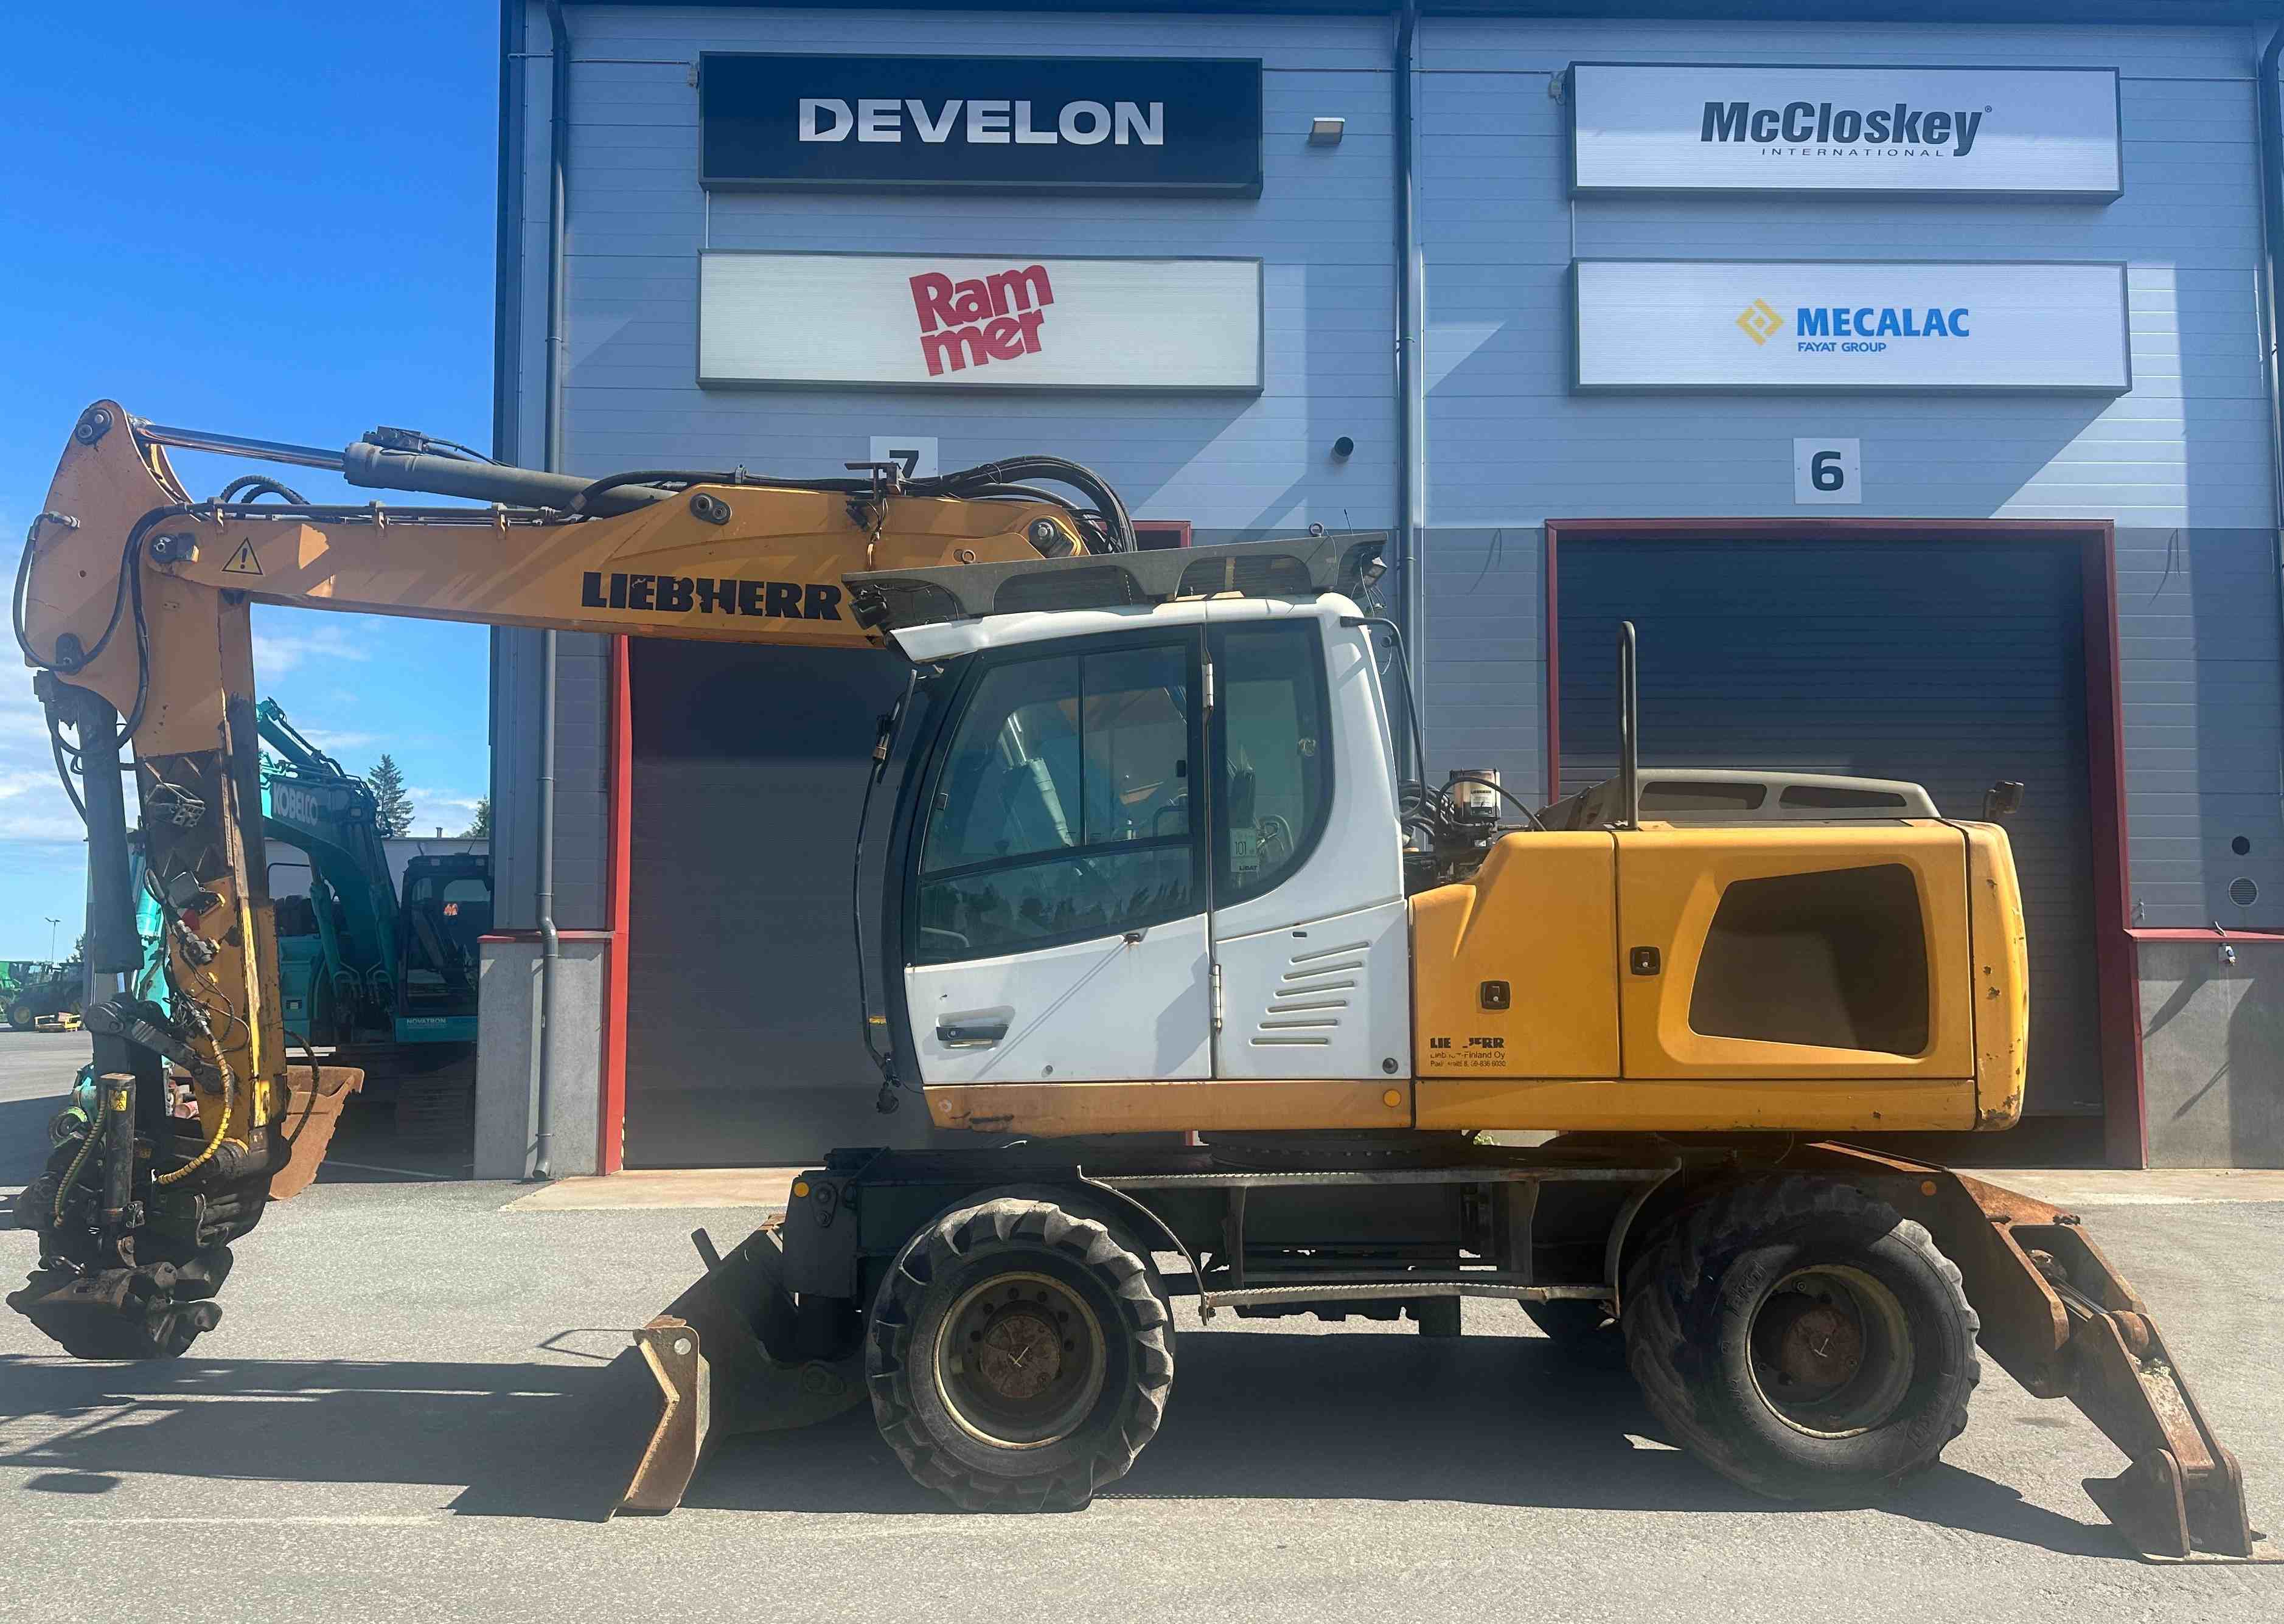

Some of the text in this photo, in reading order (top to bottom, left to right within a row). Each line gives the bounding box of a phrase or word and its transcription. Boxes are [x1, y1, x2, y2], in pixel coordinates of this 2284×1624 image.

[799, 98, 1163, 145] DEVELON
[1761, 148, 1945, 157] INTERNATIONAL
[1797, 308, 1970, 337] MECALAC
[1798, 342, 1887, 353] FAYAT GROUP
[889, 449, 919, 479] 7
[1811, 451, 1844, 491] 6
[582, 571, 842, 620] LIEBHERR
[273, 782, 318, 827] KOBELCO
[1494, 1051, 1505, 1060] Oy
